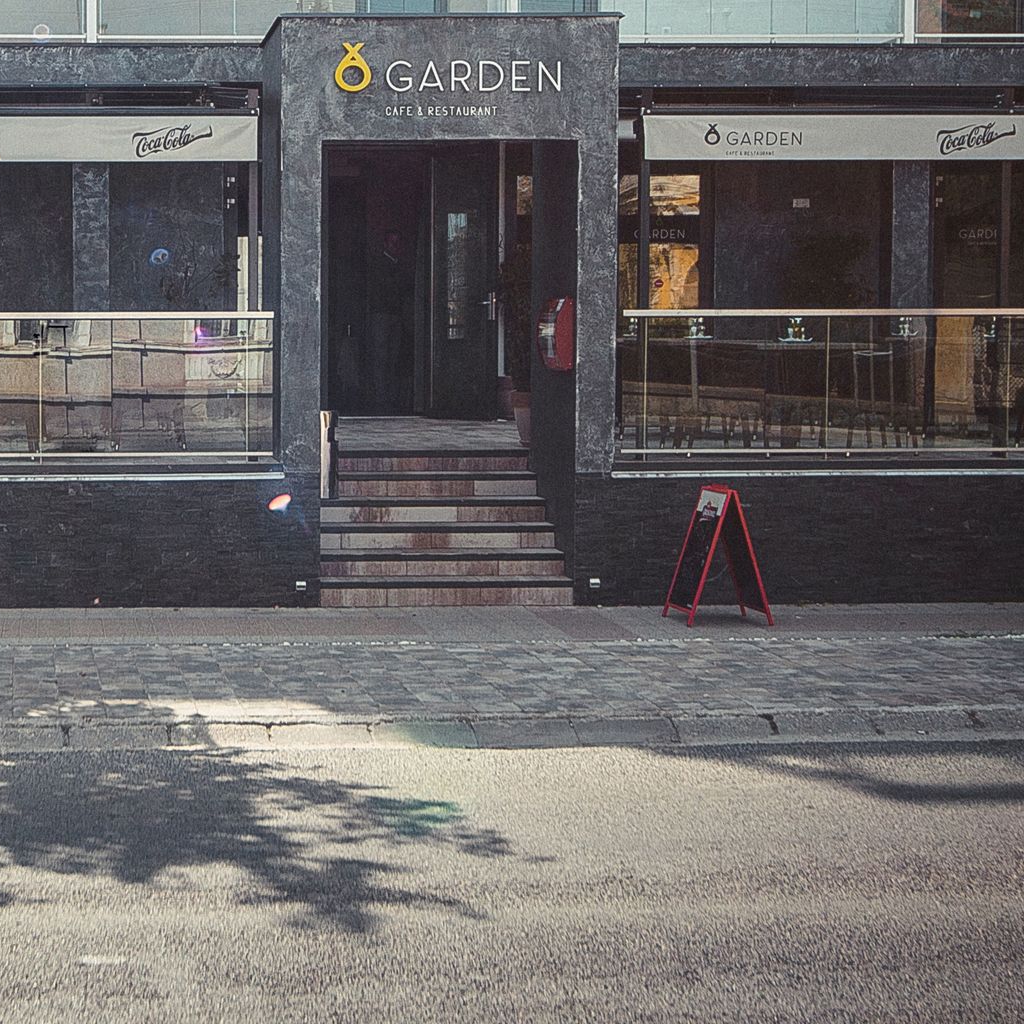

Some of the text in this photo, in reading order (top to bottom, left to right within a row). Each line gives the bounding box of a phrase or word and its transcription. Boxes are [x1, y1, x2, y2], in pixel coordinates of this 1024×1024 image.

[385, 60, 562, 93] GARDEN
[385, 106, 497, 116] CAFE & RESTAURANT
[132, 123, 213, 158] Coca-Cola
[726, 131, 803, 146] GARDEN
[937, 121, 1016, 155] Coca-Cola
[633, 229, 686, 239] GRDEN
